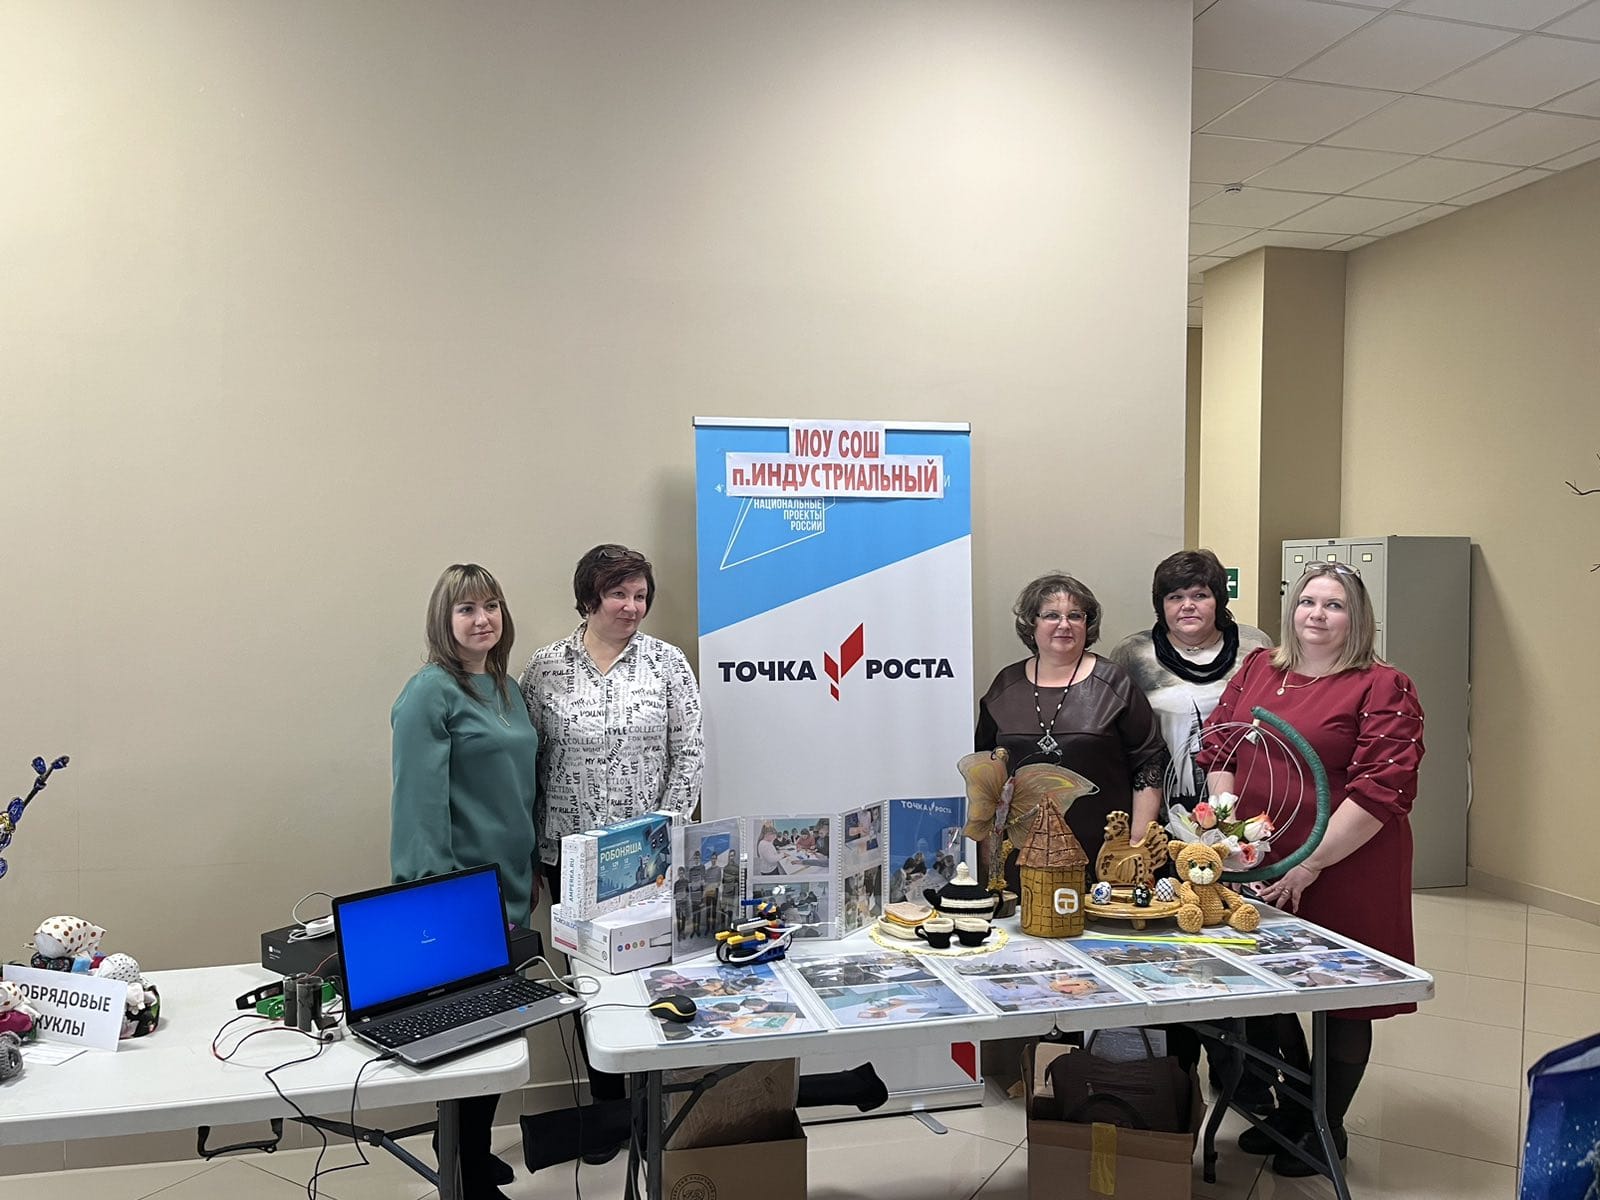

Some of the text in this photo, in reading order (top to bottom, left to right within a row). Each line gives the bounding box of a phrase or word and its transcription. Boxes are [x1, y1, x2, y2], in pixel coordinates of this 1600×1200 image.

[795, 429, 880, 458] МОУ СОШ
[732, 459, 938, 493] п.ИНДУСТРИАЛЬНЫЙ
[753, 499, 822, 510] НАЦИОНАЛЬНЫЕ
[783, 510, 822, 520] ПРОЕКТЫ
[791, 521, 822, 531] РОССИИ
[718, 658, 954, 682] ТОЧКА РОСТА
[901, 800, 928, 811] ТОЧКА
[600, 842, 642, 863] РОБОНЯША
[19, 983, 112, 1012] ОБРЯДОВЫЕ
